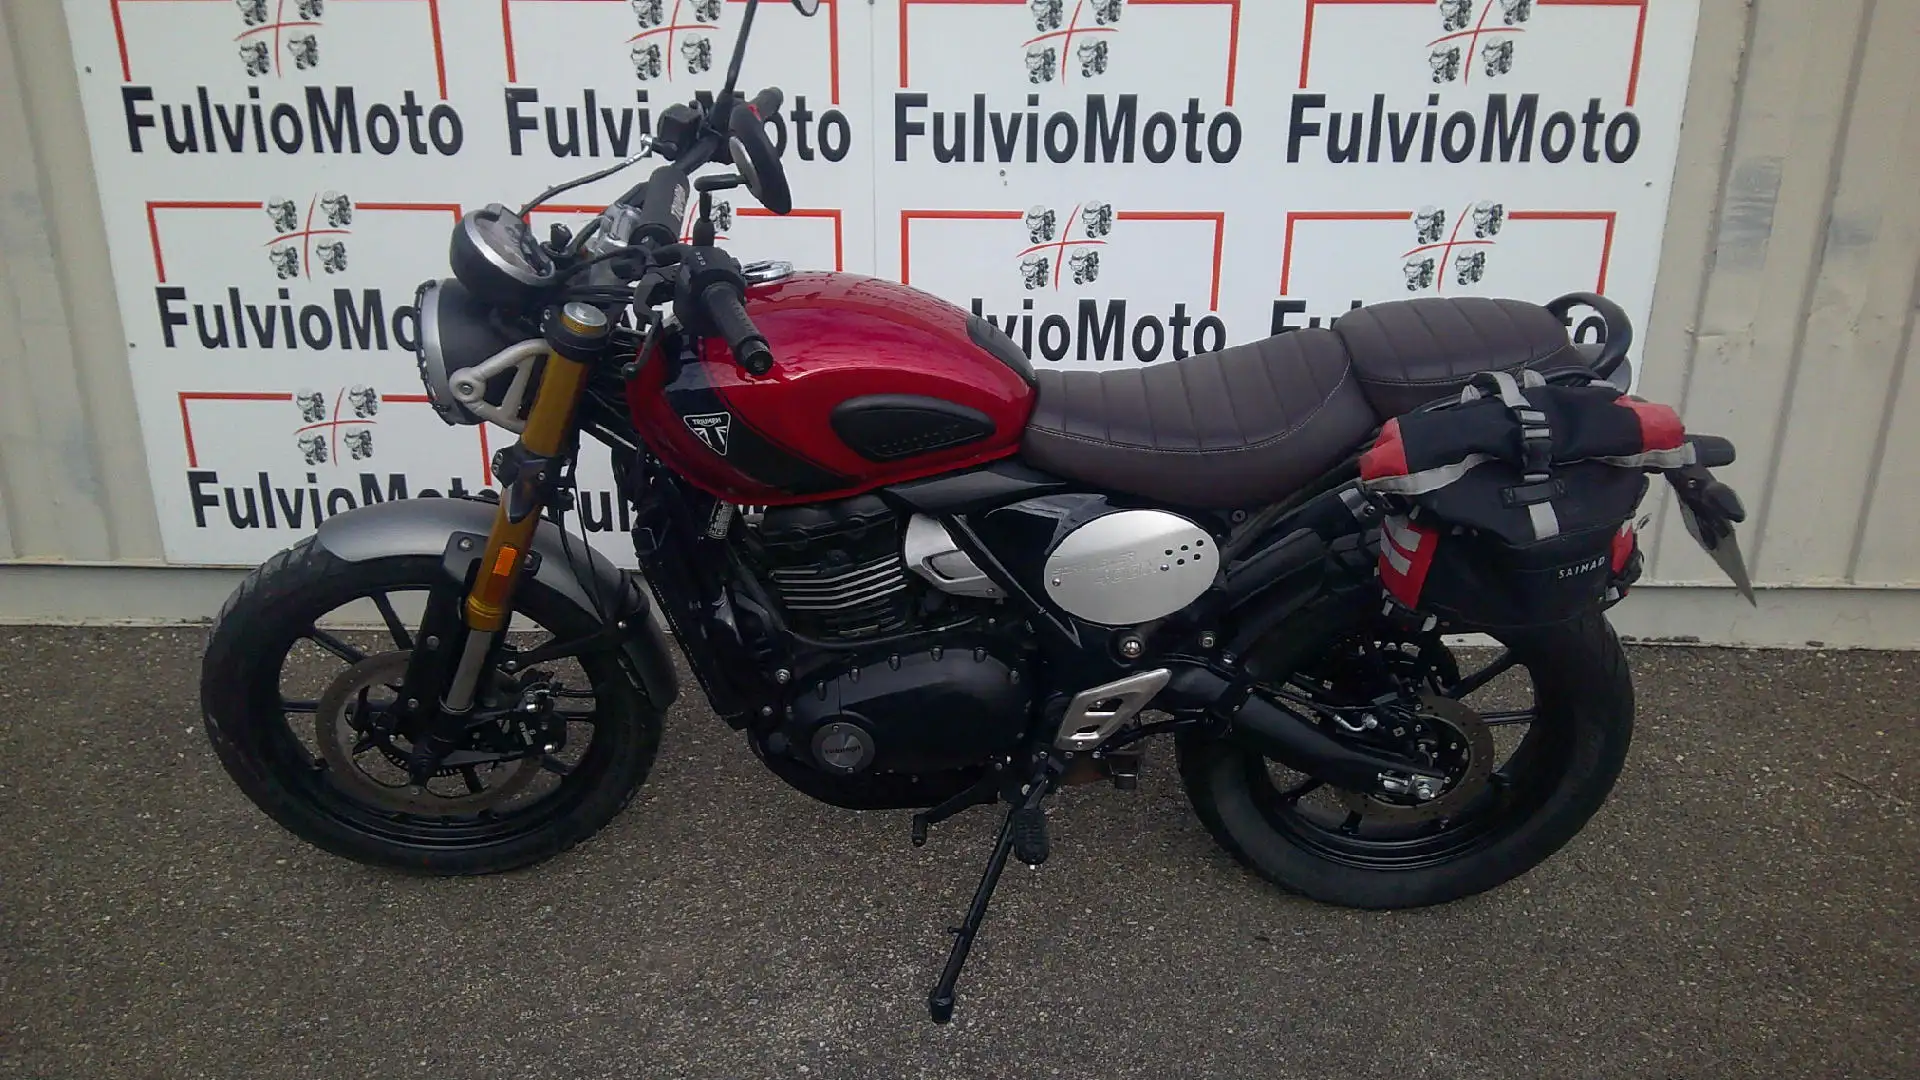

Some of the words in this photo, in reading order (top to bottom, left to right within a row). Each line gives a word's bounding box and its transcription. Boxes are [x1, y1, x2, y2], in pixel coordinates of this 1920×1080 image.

[121, 86, 463, 156] FulvioMoto
[504, 87, 851, 162] Fulvito
[894, 93, 1242, 164] FulvioMoto
[1286, 93, 1641, 164] FulvioMoto
[155, 286, 417, 351] FulvioMo
